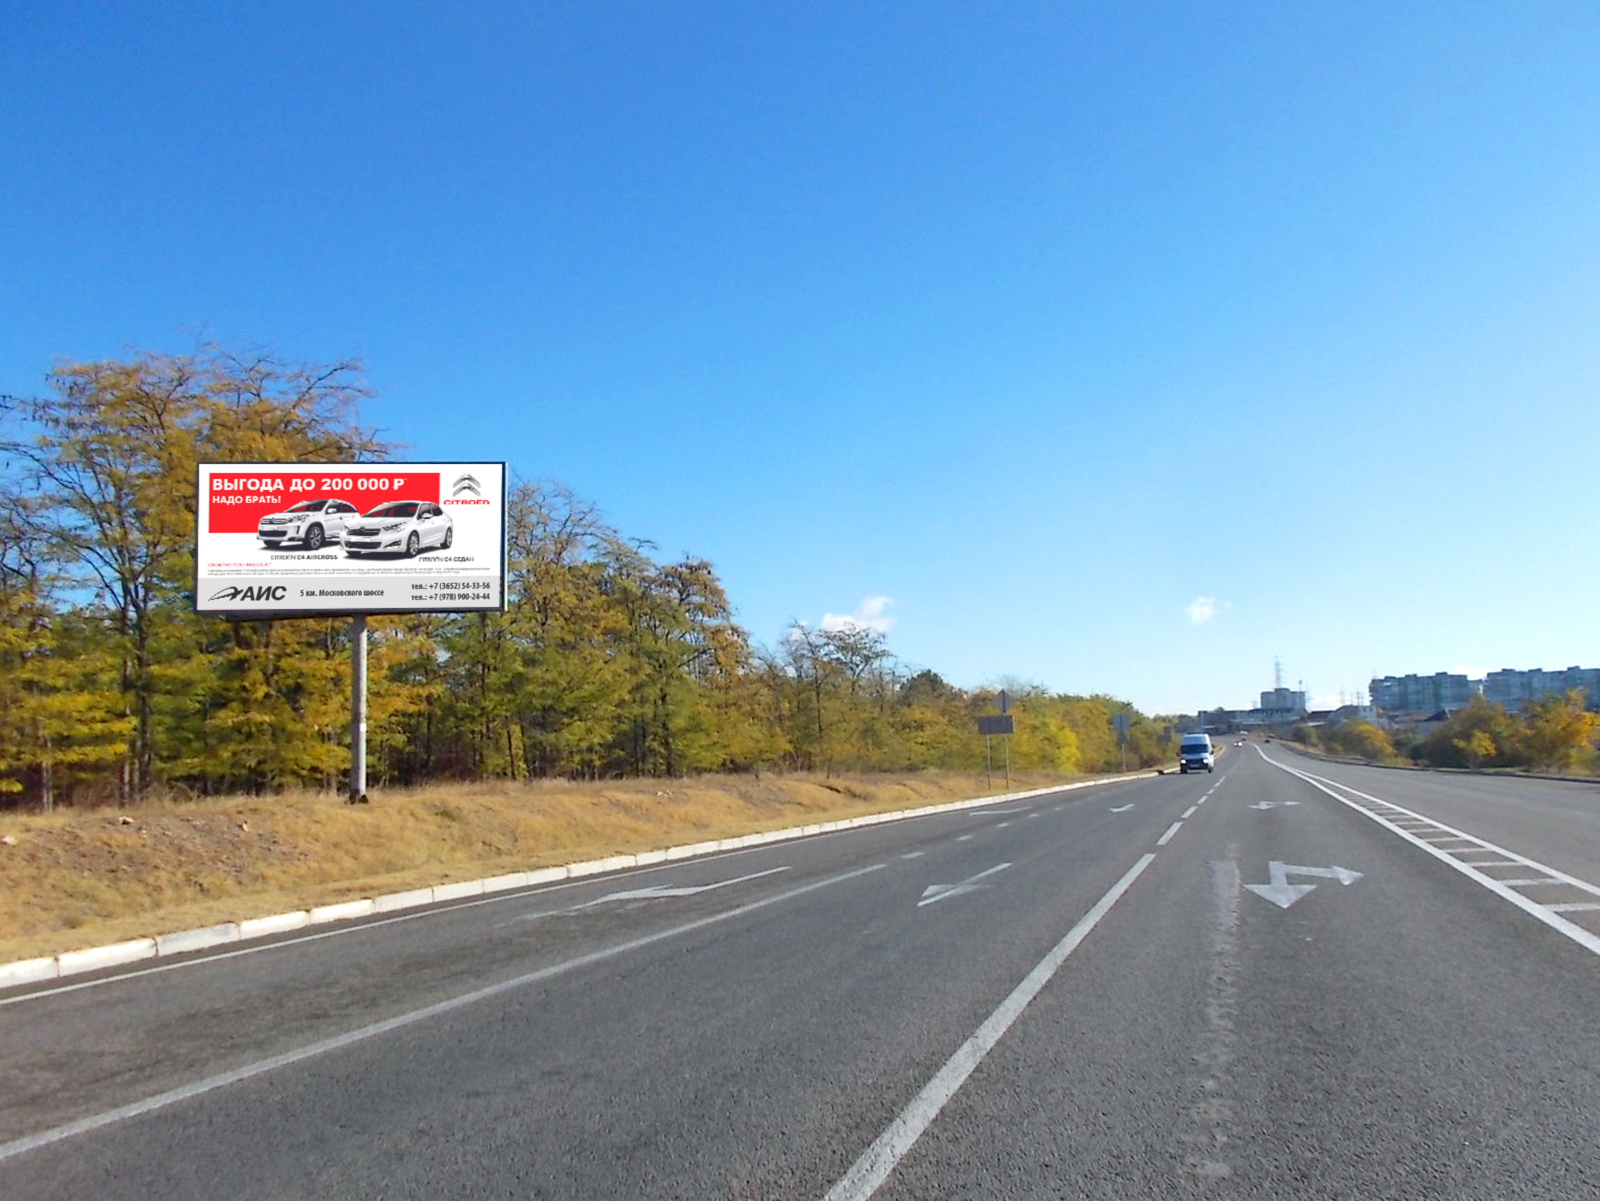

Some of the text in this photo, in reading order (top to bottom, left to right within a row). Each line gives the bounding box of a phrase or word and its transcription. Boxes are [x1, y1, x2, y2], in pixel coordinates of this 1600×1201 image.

[212, 478, 285, 492] ВЫГОДА
[289, 478, 316, 492] ДО
[320, 478, 355, 491] 200
[357, 478, 390, 490] 000
[212, 495, 282, 505] НАДО БРАТЬ!
[428, 582, 438, 590] +7
[439, 582, 460, 590] (3652)
[461, 582, 491, 590] 54-33-56
[239, 585, 287, 601] АИС
[299, 589, 304, 597] 5
[318, 589, 362, 597] Московского
[428, 593, 438, 601] +7
[439, 593, 456, 601] (978)
[457, 593, 490, 601] 900-24-44
